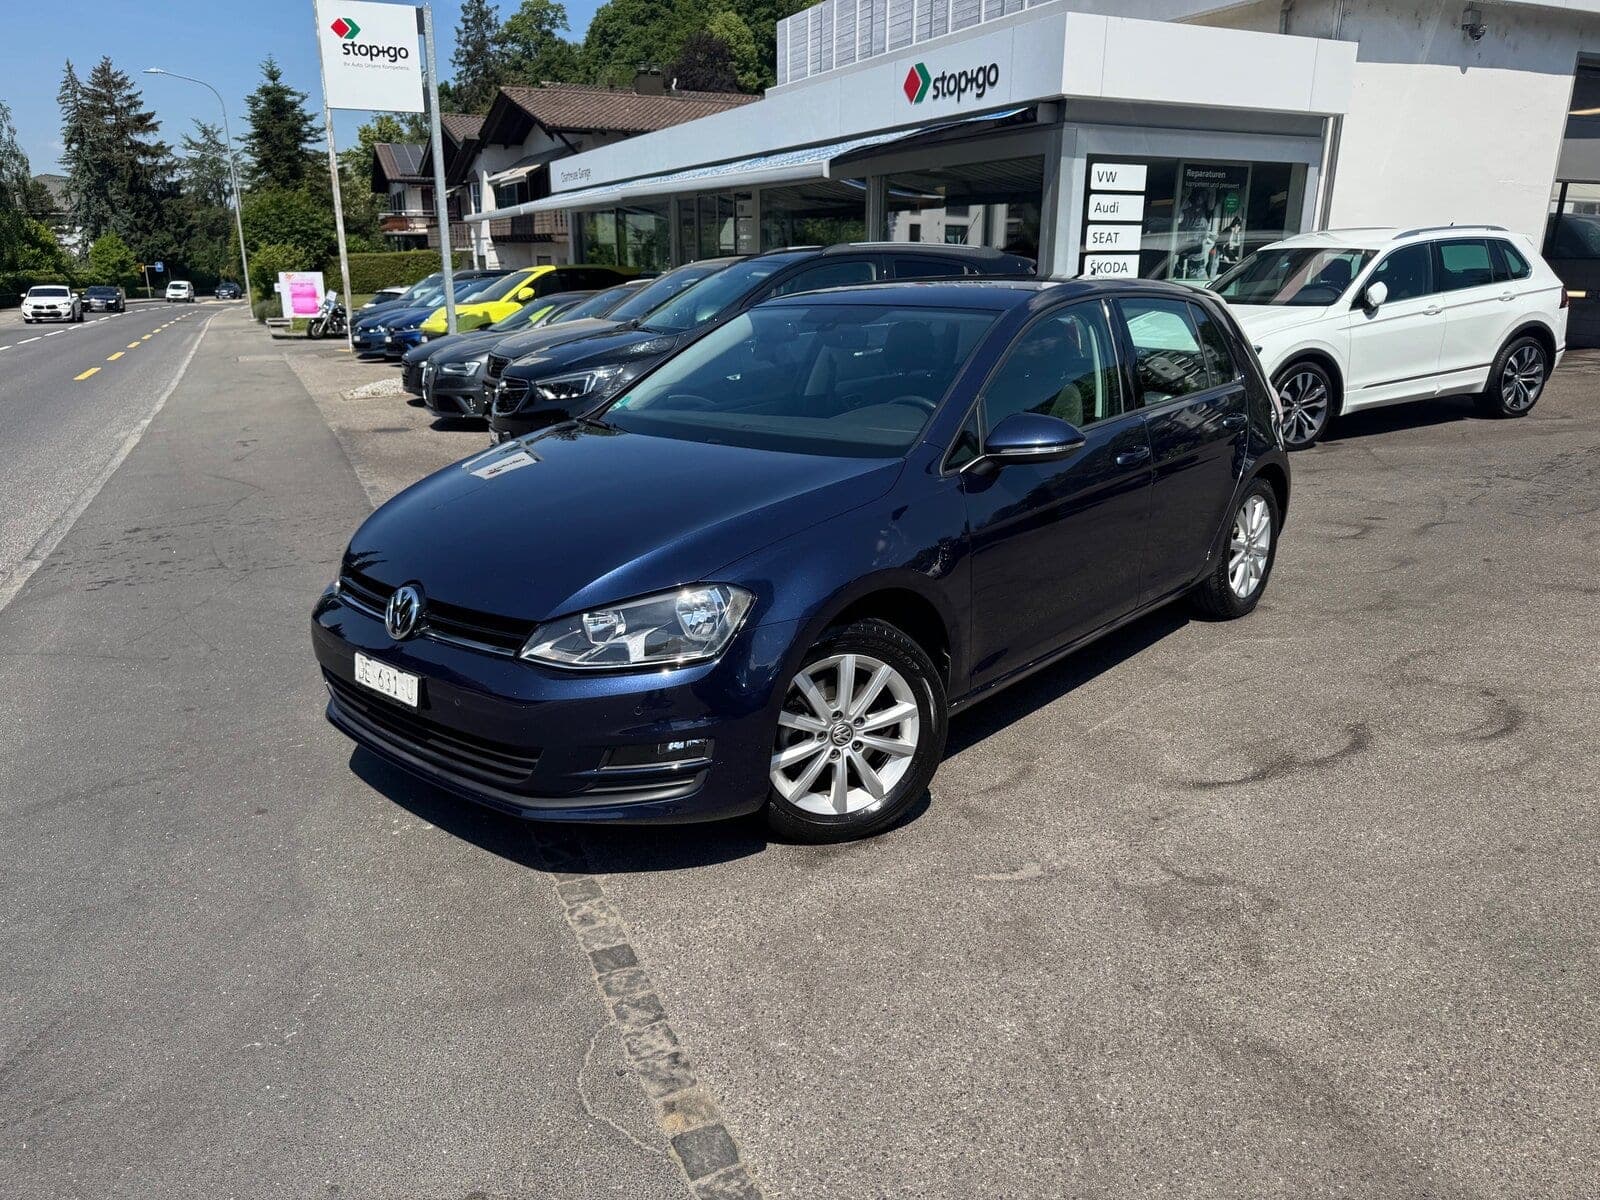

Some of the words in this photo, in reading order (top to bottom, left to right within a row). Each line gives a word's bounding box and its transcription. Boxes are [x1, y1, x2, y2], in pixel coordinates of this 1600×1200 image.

[342, 41, 409, 62] stop+go
[933, 63, 999, 103] stop+go
[1097, 171, 1117, 183] VW
[1186, 169, 1226, 179] Reparaturen
[1094, 202, 1119, 213] Audi
[1092, 232, 1120, 244] SEAT
[1090, 260, 1128, 274] ŠKODA
